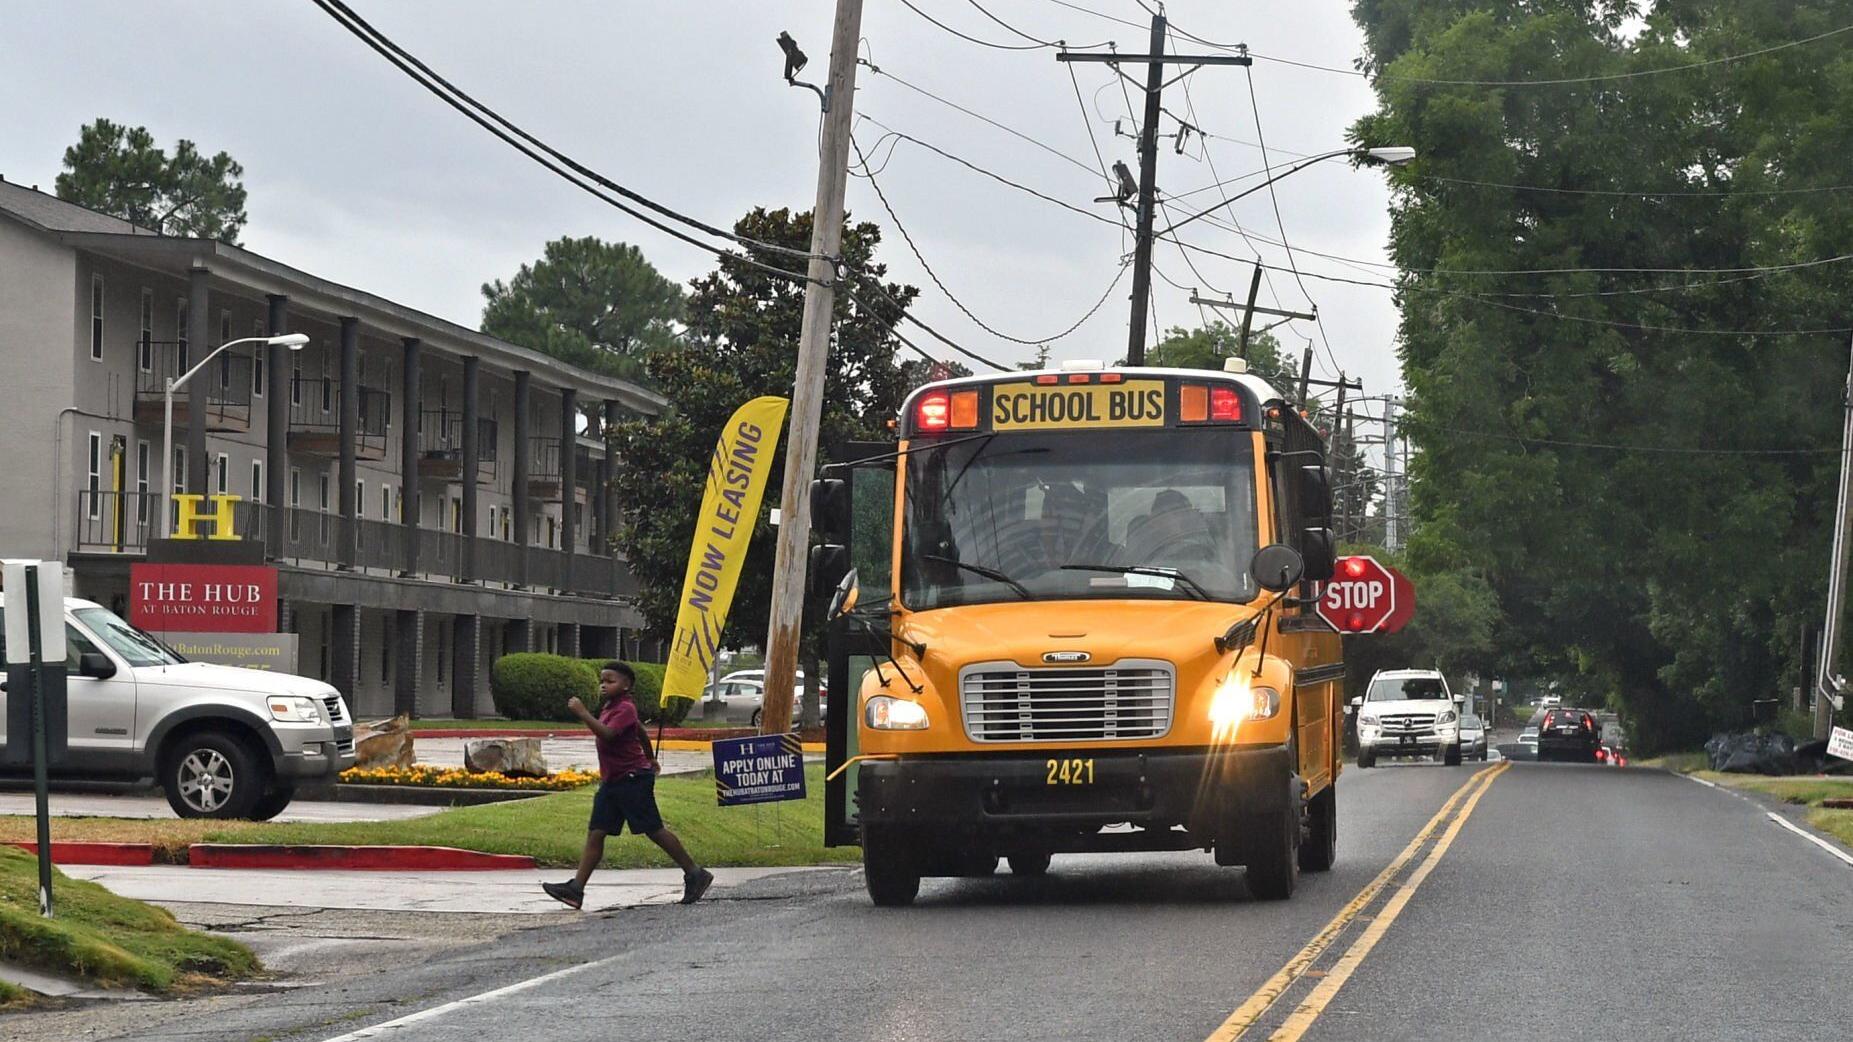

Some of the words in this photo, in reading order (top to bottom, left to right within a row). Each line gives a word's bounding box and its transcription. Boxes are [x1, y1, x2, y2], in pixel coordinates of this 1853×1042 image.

[995, 392, 1101, 424] SCHOOL
[1109, 390, 1162, 420] BUS
[170, 494, 242, 540] H
[689, 543, 726, 612] NOW
[711, 421, 762, 540] LEASING
[139, 582, 193, 601] THE
[204, 584, 261, 603] HUB
[1327, 581, 1383, 610] STOP
[141, 604, 156, 614] AT
[163, 604, 206, 615] BATON
[212, 605, 259, 616] ROUGE
[740, 743, 753, 755] H
[723, 758, 754, 775] APPLY
[756, 754, 796, 771] ONLINE
[1046, 758, 1094, 785] 2421
[736, 770, 769, 787] TODAY
[772, 769, 784, 784] AT
